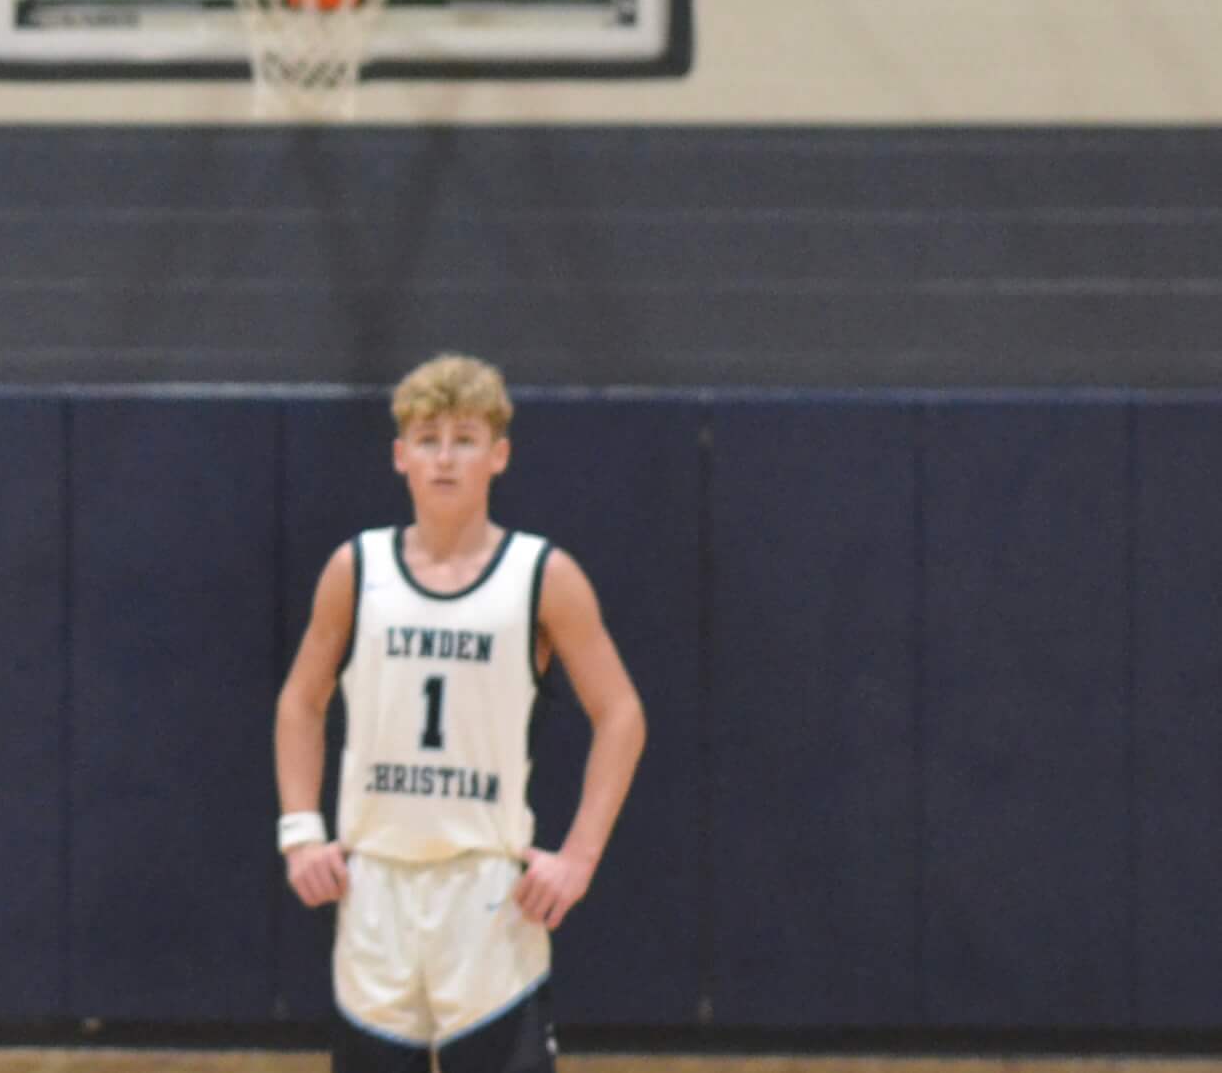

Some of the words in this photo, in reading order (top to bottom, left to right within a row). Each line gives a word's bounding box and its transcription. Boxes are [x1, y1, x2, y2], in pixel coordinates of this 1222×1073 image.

[386, 626, 494, 662] LYNDEN
[419, 674, 447, 750] 1
[366, 762, 500, 803] HRISTIAN
